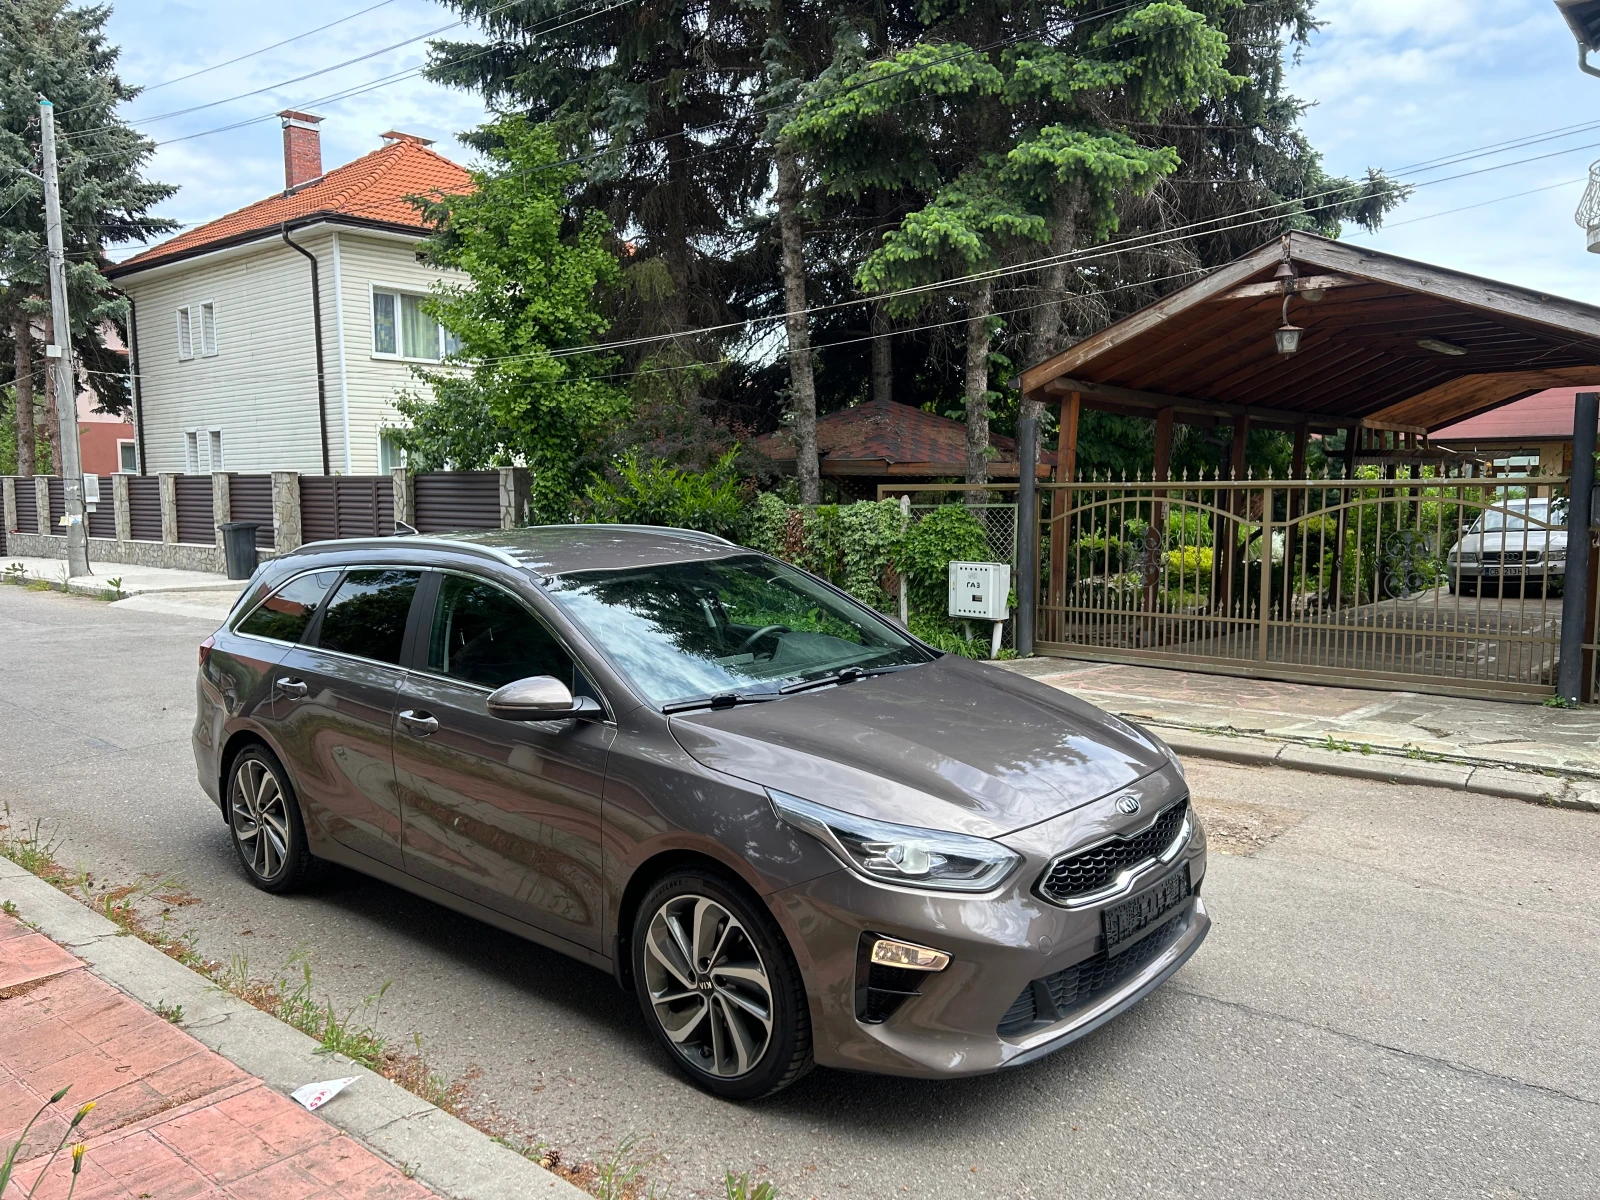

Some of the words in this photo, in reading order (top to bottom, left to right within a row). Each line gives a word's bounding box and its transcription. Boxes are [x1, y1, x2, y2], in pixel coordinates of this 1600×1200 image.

[1489, 567, 1527, 576] CB213H
[966, 581, 981, 589] ГАЗ
[1118, 797, 1139, 813] KIA
[699, 981, 713, 989] KIA
